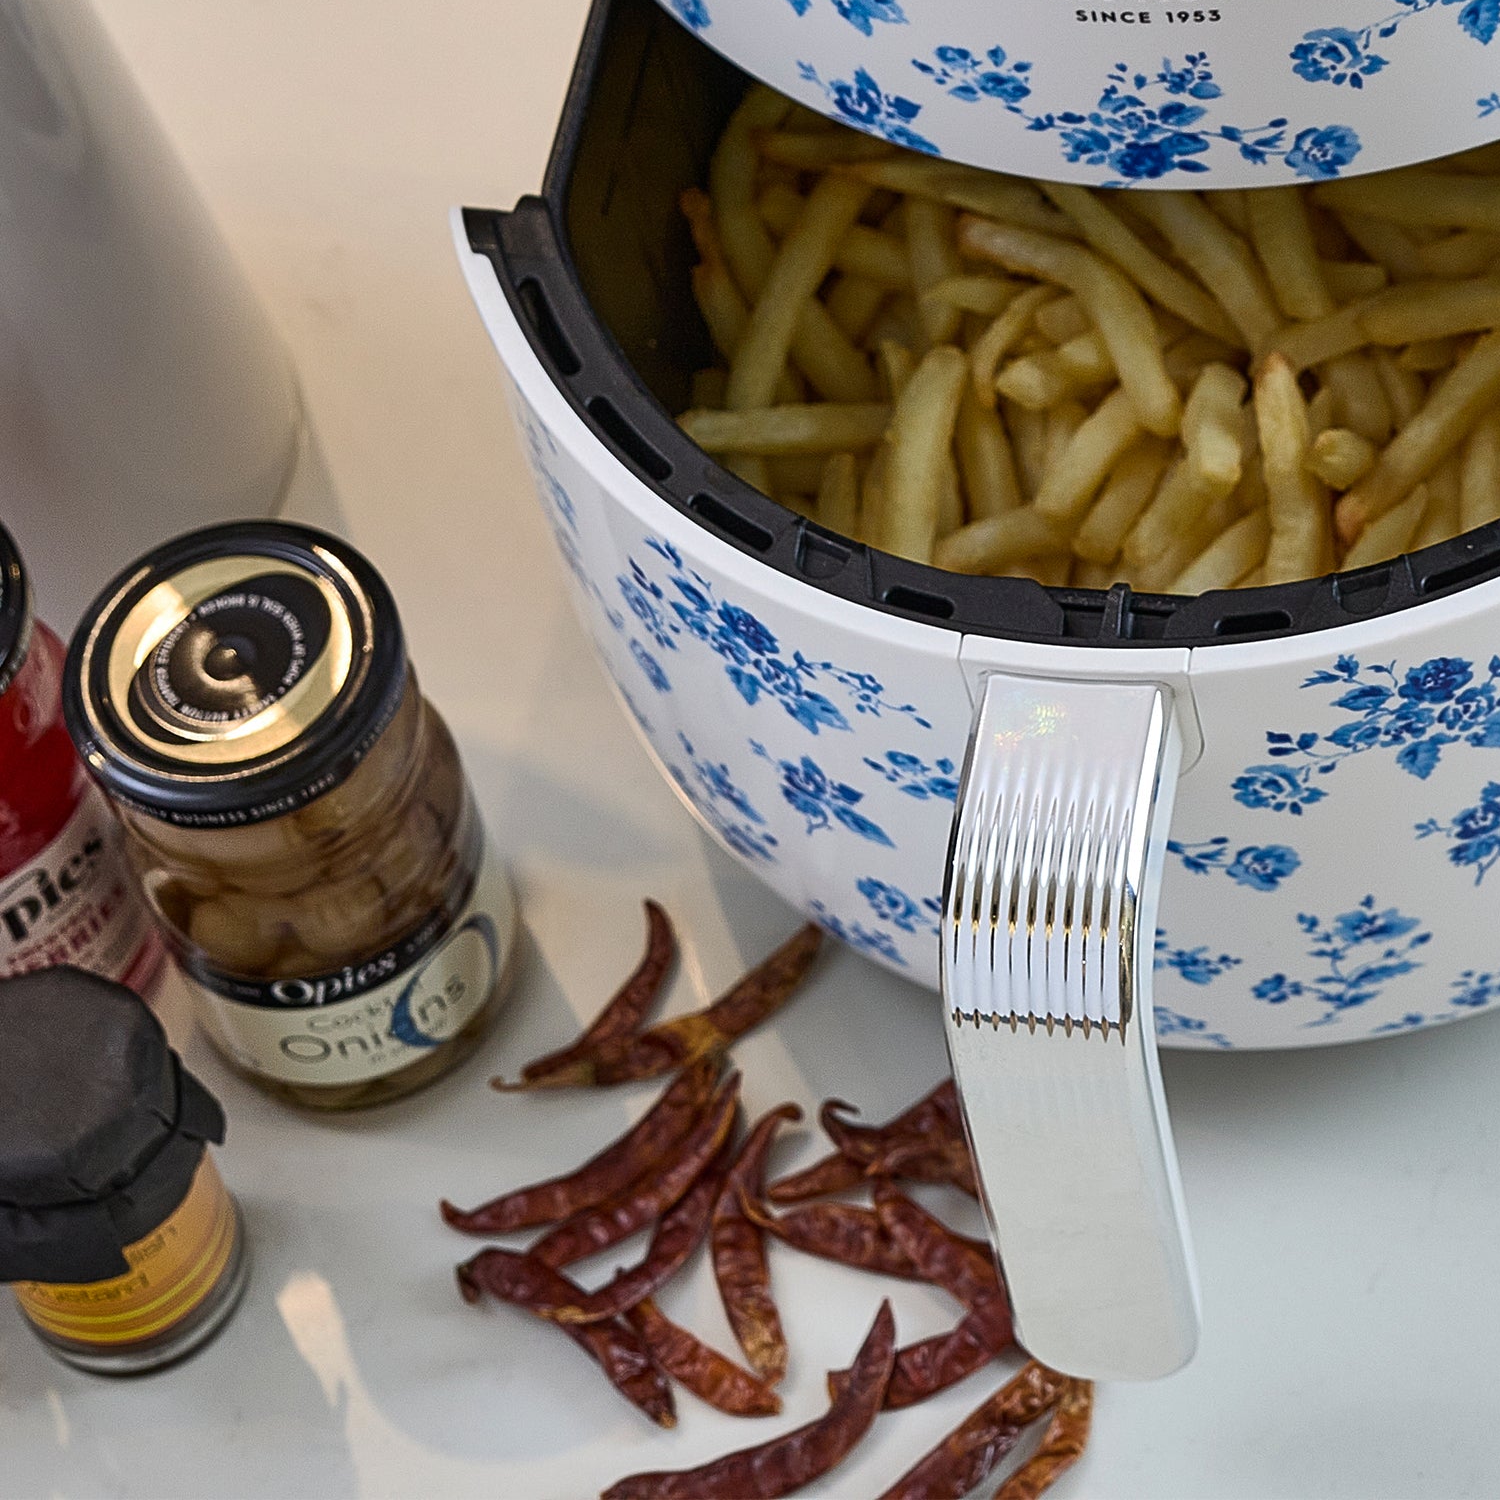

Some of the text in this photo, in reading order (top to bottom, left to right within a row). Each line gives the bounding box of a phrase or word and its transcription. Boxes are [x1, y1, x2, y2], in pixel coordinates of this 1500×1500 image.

[1075, 8, 1222, 25] SINCE 1953
[269, 951, 398, 1006] Opies
